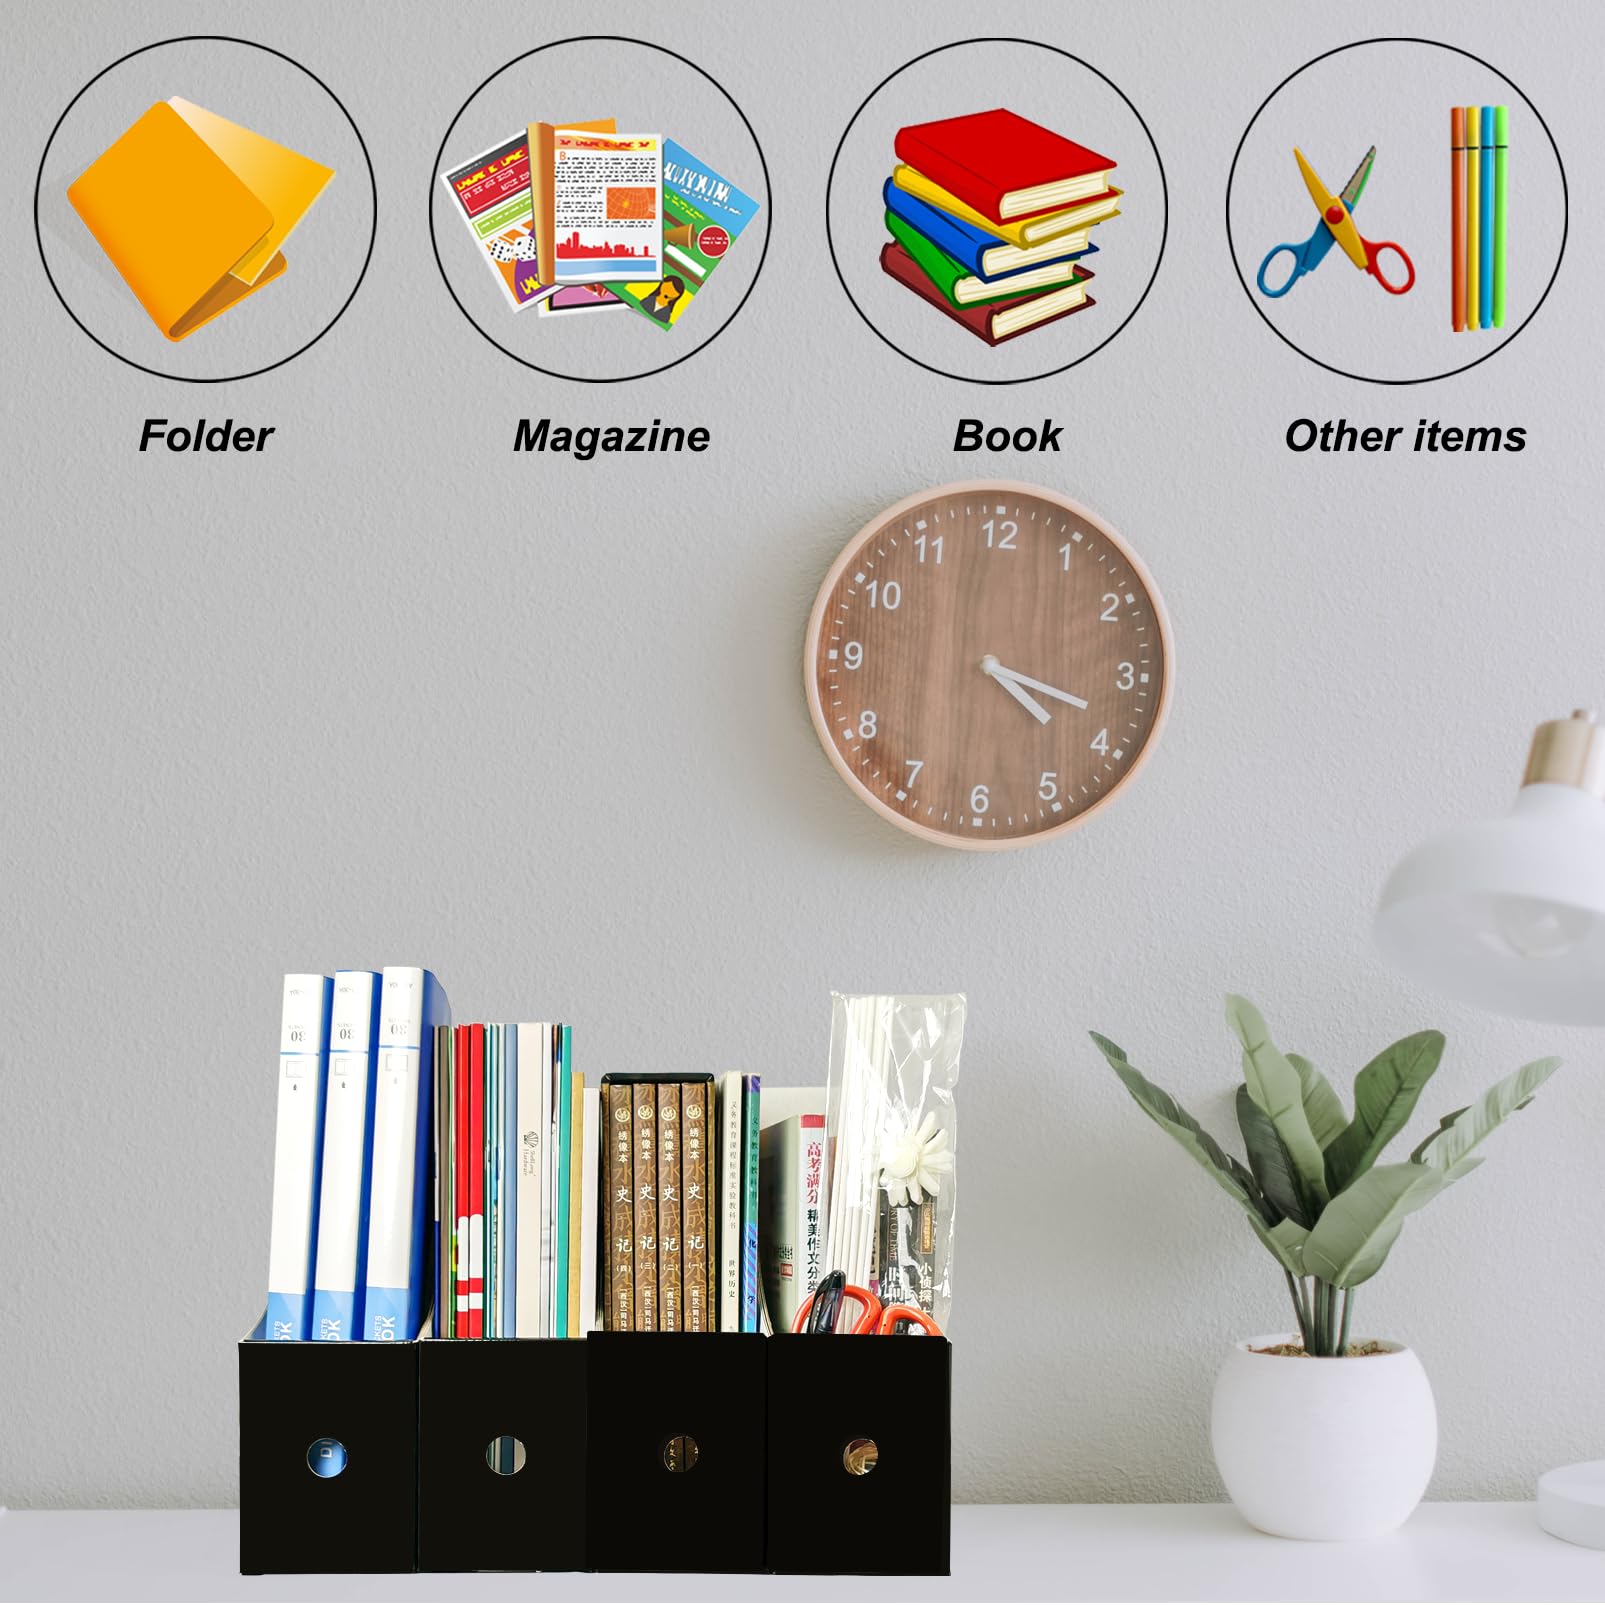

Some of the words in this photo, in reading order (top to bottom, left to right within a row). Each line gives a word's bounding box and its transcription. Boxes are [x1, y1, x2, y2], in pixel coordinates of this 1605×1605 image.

[982, 519, 1018, 550] 12
[914, 535, 944, 565] 11
[1058, 543, 1072, 571] 1
[866, 581, 901, 610] 10
[1100, 593, 1119, 622] 2
[844, 641, 863, 670] 9
[1116, 662, 1135, 690] 3
[858, 710, 877, 739] 8
[1089, 728, 1109, 757] 4
[905, 760, 924, 788] 7
[1038, 771, 1058, 801] 5
[970, 784, 989, 814] 6
[806, 1142, 821, 1204] 高考满分
[728, 1260, 736, 1297] 世界历史
